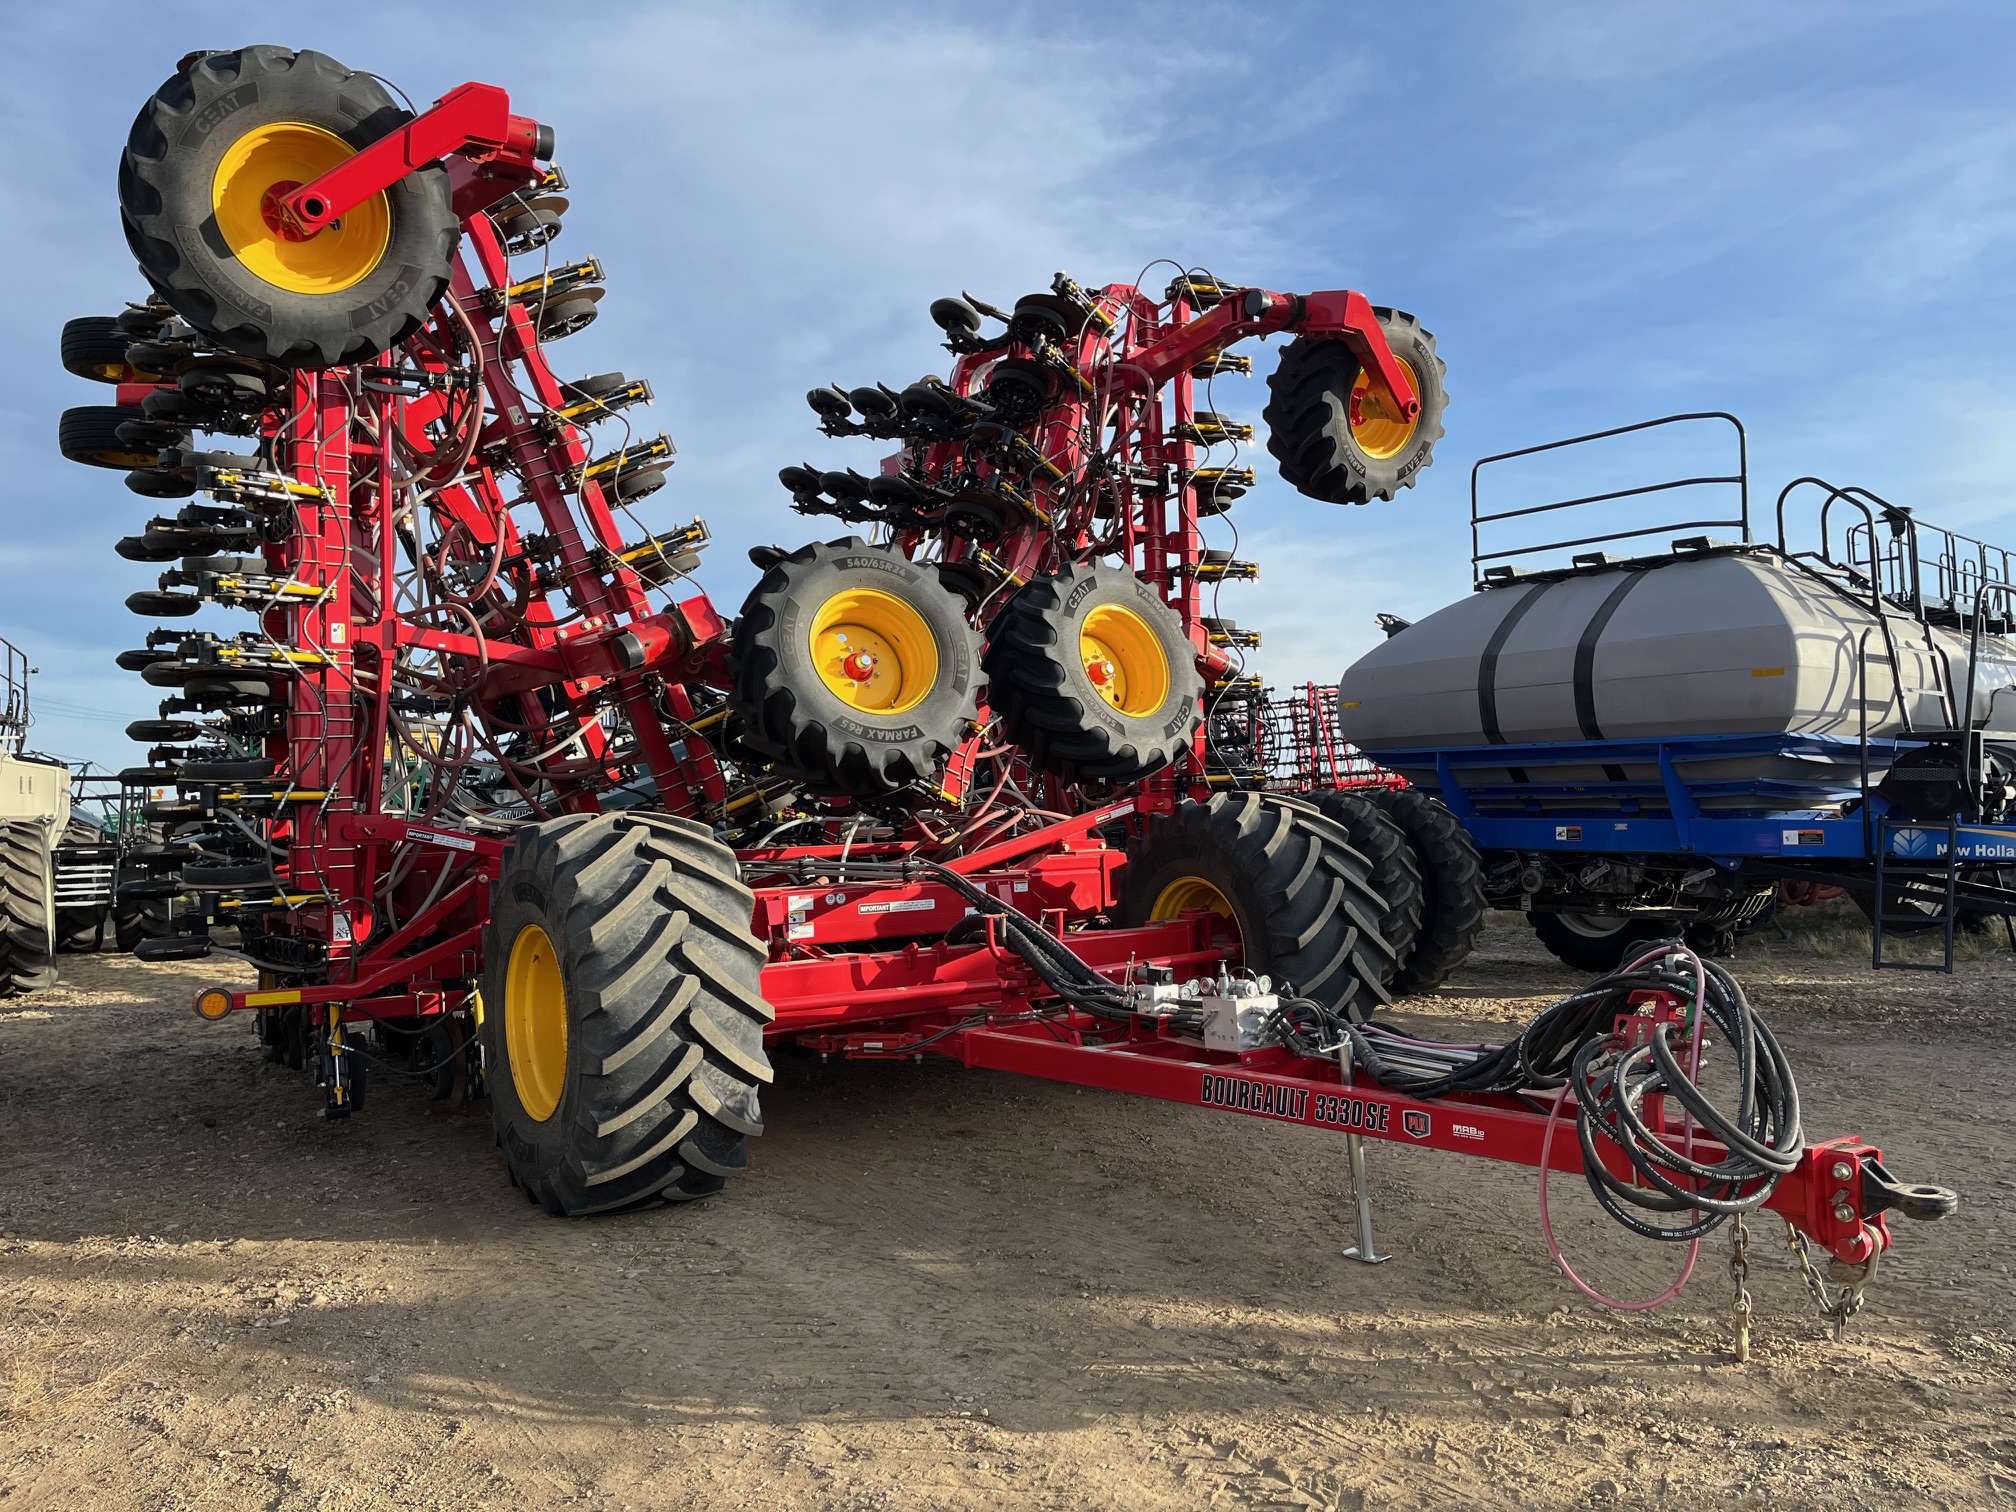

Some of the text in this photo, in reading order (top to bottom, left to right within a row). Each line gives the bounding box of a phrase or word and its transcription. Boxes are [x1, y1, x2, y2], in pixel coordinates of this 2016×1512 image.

[195, 91, 240, 133] CEAT
[368, 280, 409, 320] CEAT
[1404, 450, 1424, 475] CEAT
[846, 558, 906, 577] 540/65R24
[1068, 581, 1090, 609] CEAT
[781, 614, 795, 655] CEAT
[956, 641, 968, 681] CEAT
[840, 719, 918, 740] FARMAX R65
[1171, 705, 1190, 733] CEAT
[408, 831, 434, 840] IMPORTANT
[1936, 843, 2016, 857] Nw Holla
[860, 904, 890, 912] IMPORTANT
[1201, 1074, 1309, 1120] BOURGAULT
